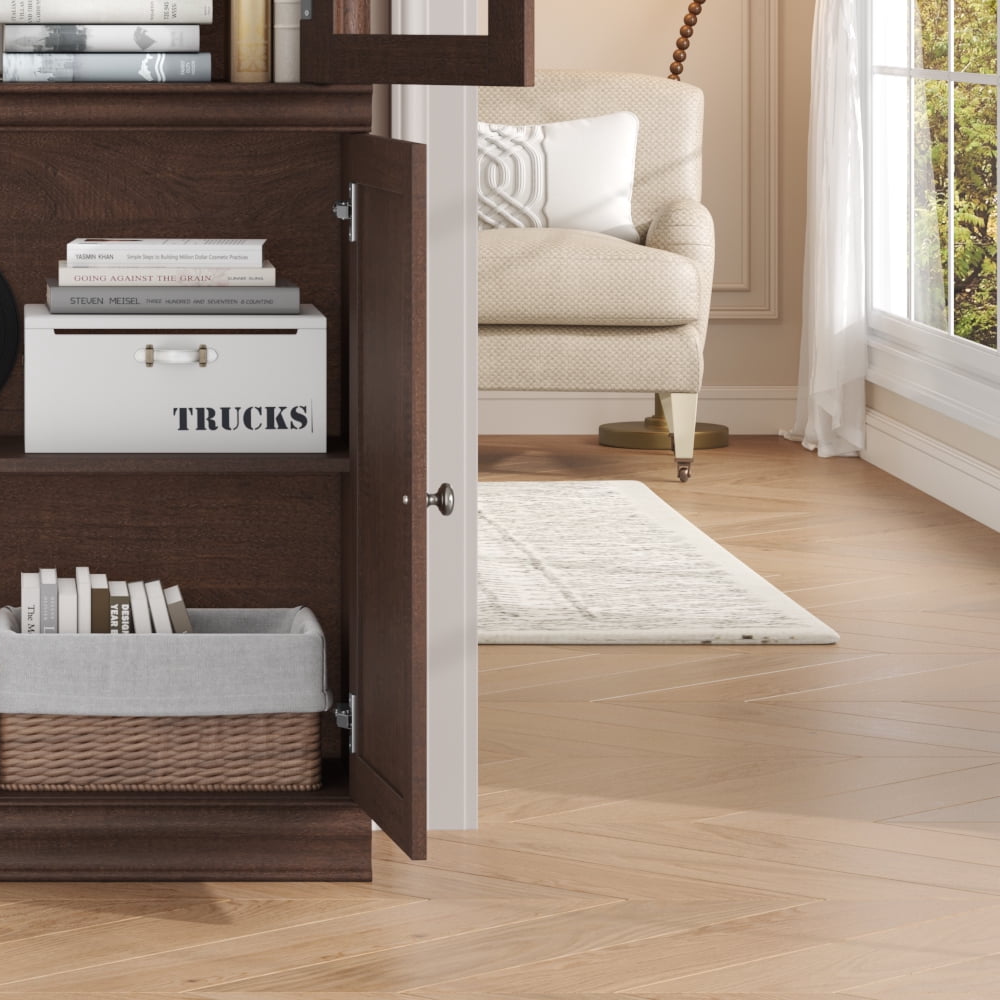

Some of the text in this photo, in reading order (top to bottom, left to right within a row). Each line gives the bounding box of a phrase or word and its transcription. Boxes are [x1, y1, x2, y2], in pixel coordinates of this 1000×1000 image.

[70, 297, 104, 305] STEVEN
[109, 297, 140, 305] MEISEL
[173, 405, 308, 431] TRUCKS
[27, 604, 36, 621] The
[110, 604, 119, 627] YEAR
